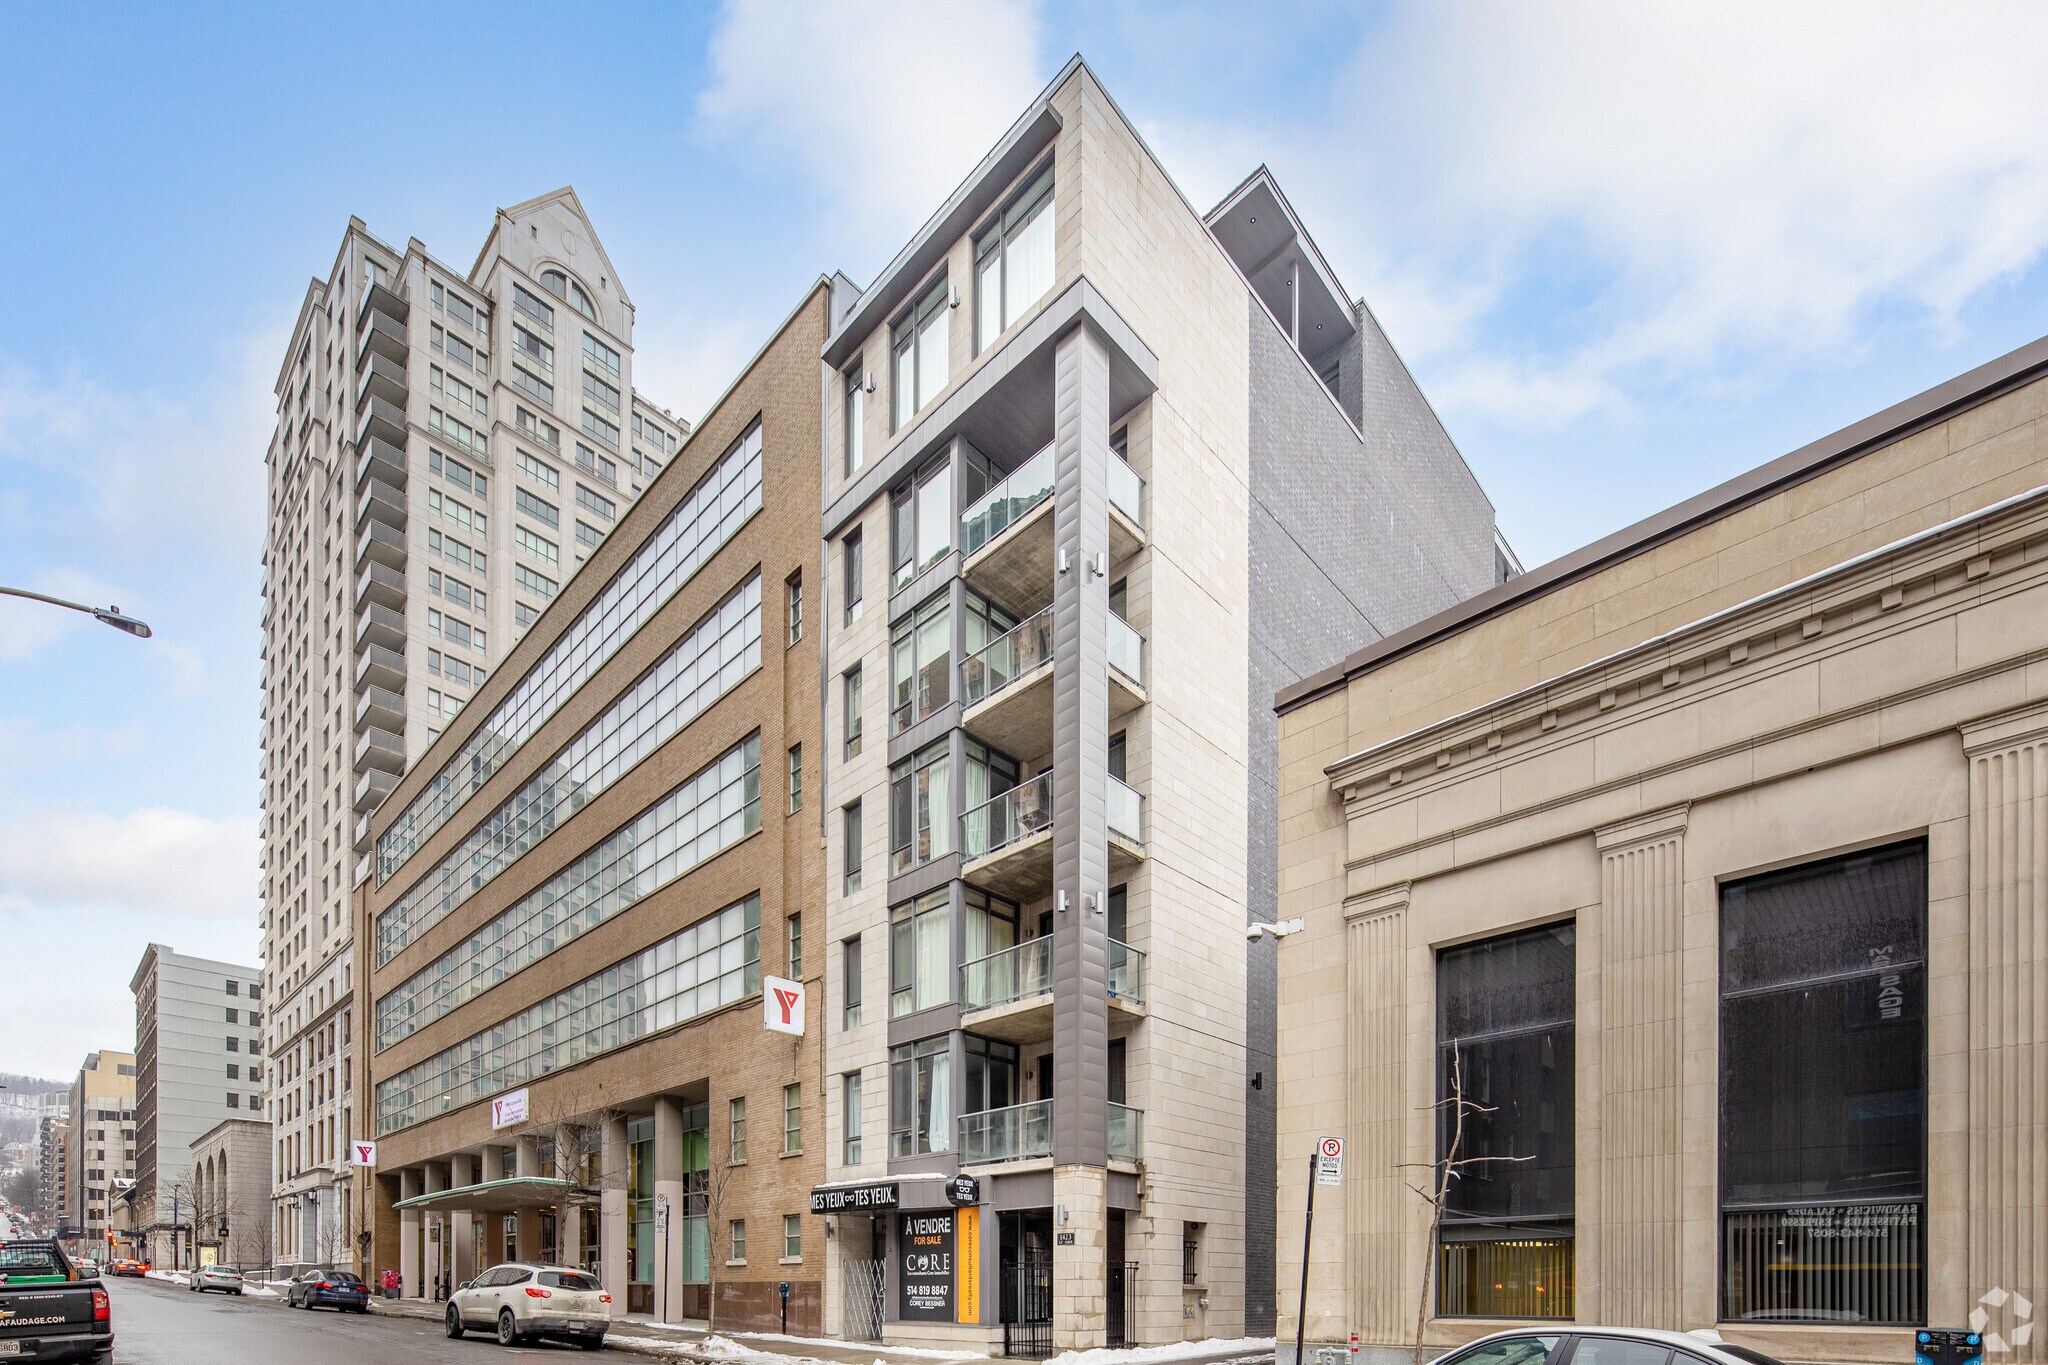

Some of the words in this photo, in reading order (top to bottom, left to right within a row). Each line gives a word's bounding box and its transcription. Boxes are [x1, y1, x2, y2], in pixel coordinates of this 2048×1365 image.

[810, 1193, 824, 1209] MES
[825, 1191, 846, 1208] YEUX
[854, 1188, 870, 1206] TES
[905, 1216, 913, 1236] À
[913, 1217, 951, 1235] VENDRE
[914, 1236, 926, 1245] FOR
[926, 1236, 942, 1245] SALE
[907, 1286, 918, 1296] 514
[918, 1285, 931, 1296] 819
[931, 1285, 949, 1296] 8847
[0, 1316, 65, 1326] AFAUDAGE.COM
